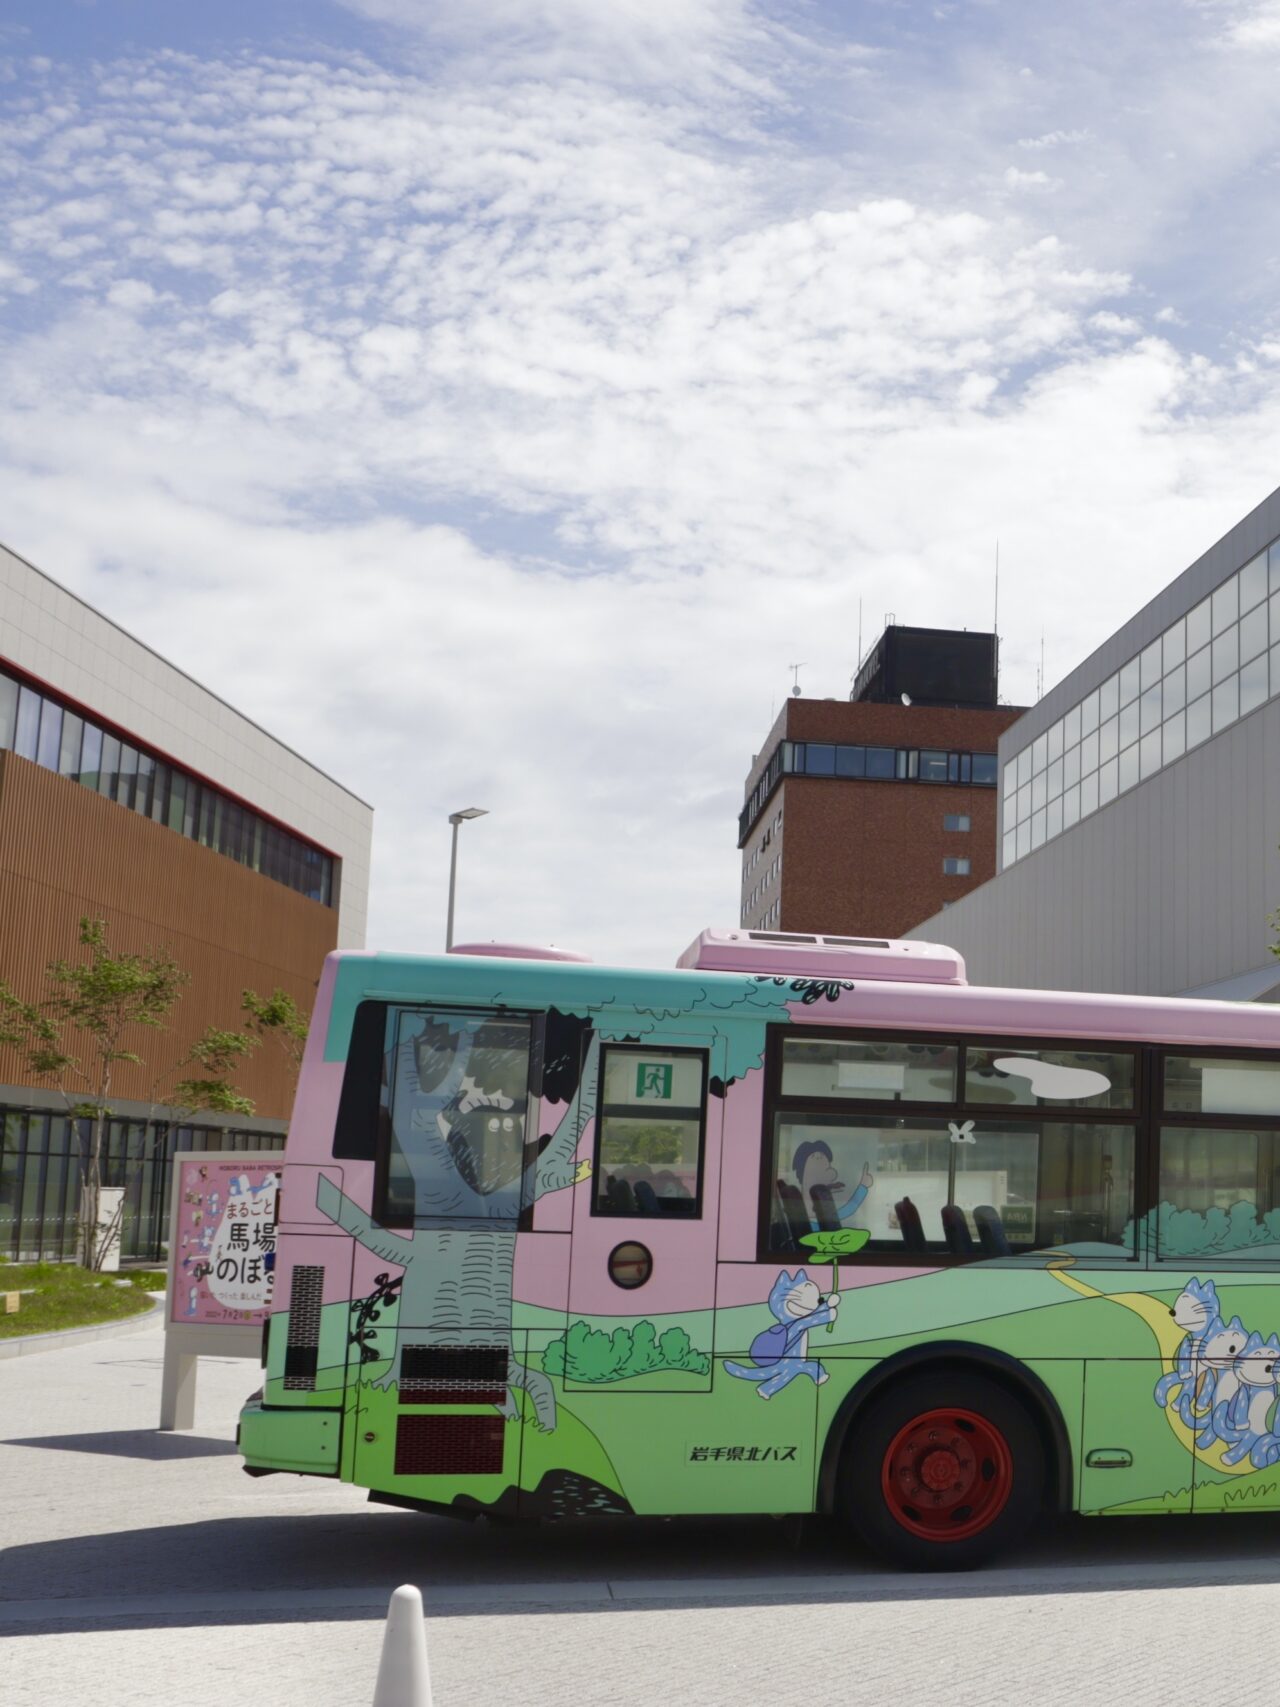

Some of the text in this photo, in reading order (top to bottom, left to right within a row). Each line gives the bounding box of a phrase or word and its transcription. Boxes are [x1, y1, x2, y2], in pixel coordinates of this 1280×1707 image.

[227, 1198, 273, 1220] まるごと
[227, 1222, 277, 1252] 馬場
[690, 1446, 798, 1461] 岩手県北バス
